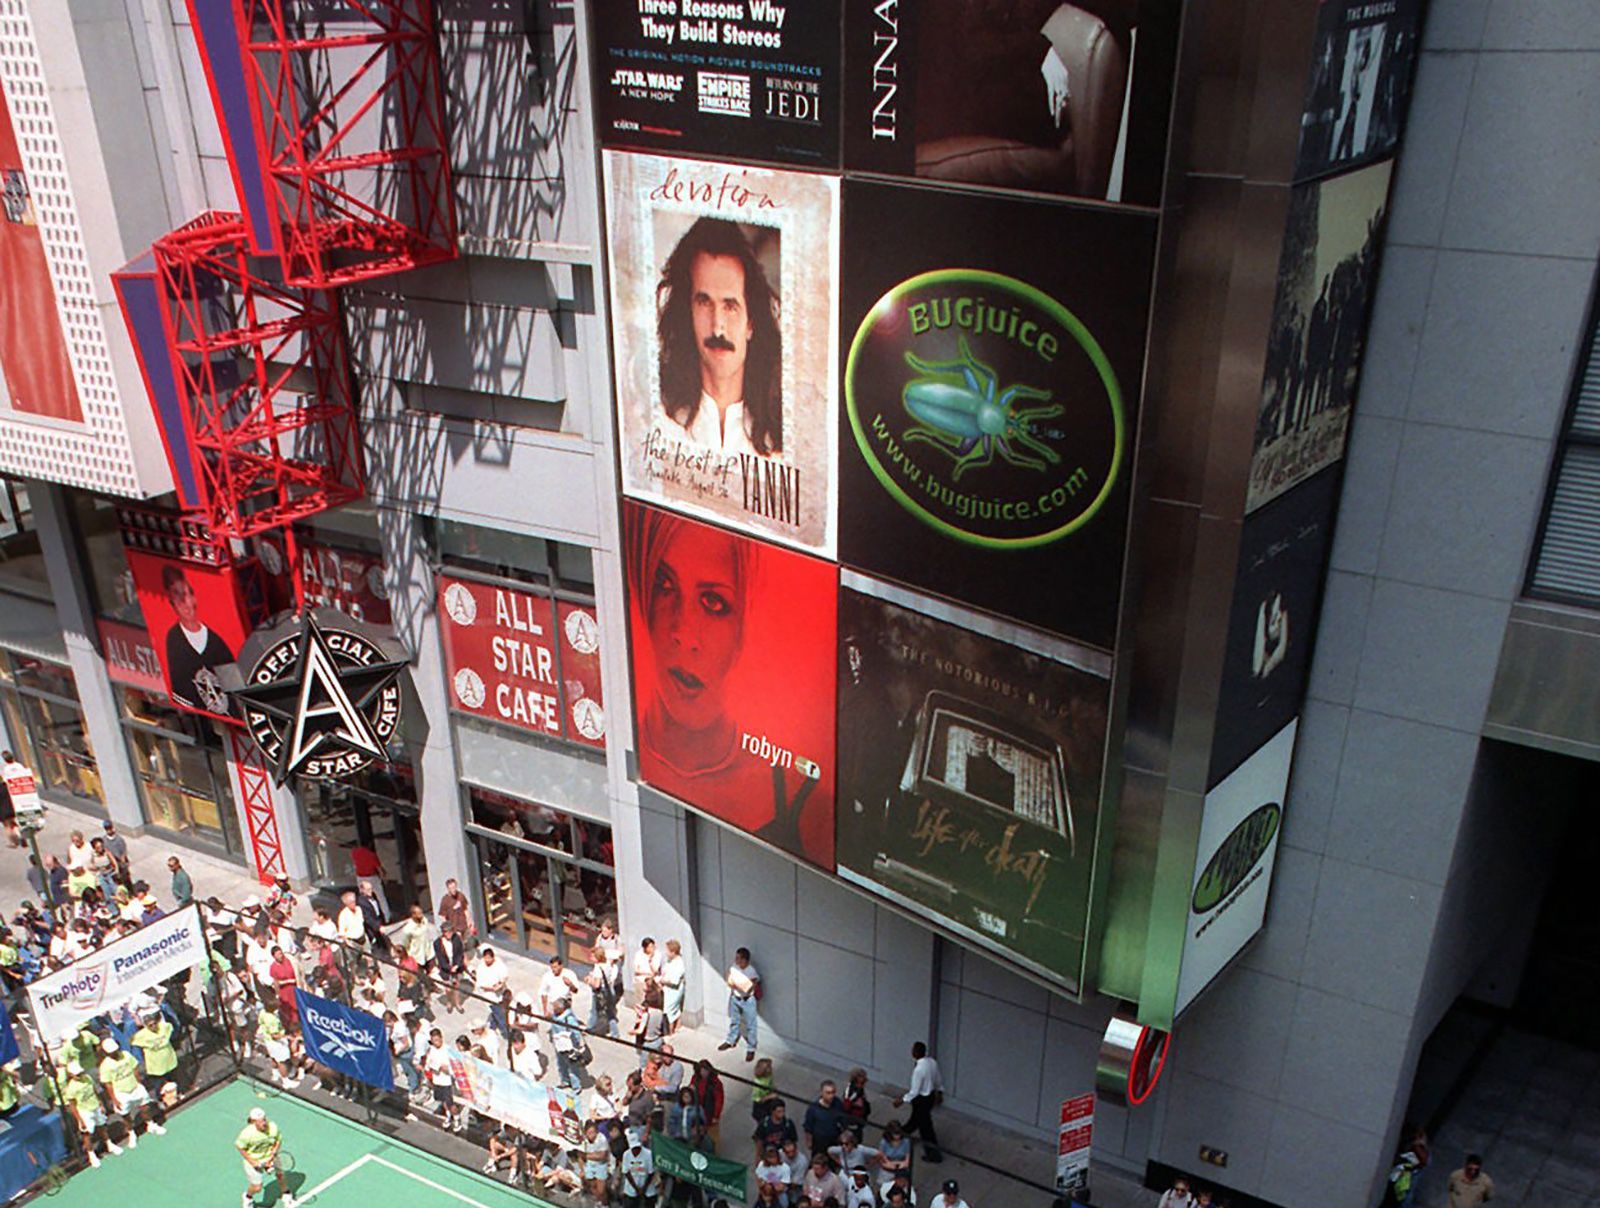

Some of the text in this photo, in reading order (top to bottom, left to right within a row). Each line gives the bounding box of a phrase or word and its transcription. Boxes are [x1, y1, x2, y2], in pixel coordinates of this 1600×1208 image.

[638, 0, 786, 29] Three Reasons Why
[641, 18, 781, 48] They Build Stereos
[611, 70, 684, 91] STAR WARS
[698, 75, 751, 100] EMPIRE
[750, 61, 823, 77] SOUNDTRACKS
[872, 0, 898, 141] INNA
[764, 90, 820, 122] JEDI
[650, 167, 783, 210] devotion
[907, 296, 1060, 362] BUGjuice
[642, 428, 801, 528] the best of YANNI
[872, 412, 1090, 520] www.bugjuice.com
[496, 589, 543, 636] ALL
[492, 635, 553, 685] STAR
[376, 686, 397, 737] CAFE
[249, 711, 286, 758] ALL
[740, 731, 793, 770] robyn
[306, 751, 364, 776] STAR
[113, 926, 191, 973] Panasonic
[40, 973, 101, 1009] TruPhoto
[306, 1007, 378, 1048] Reebok
